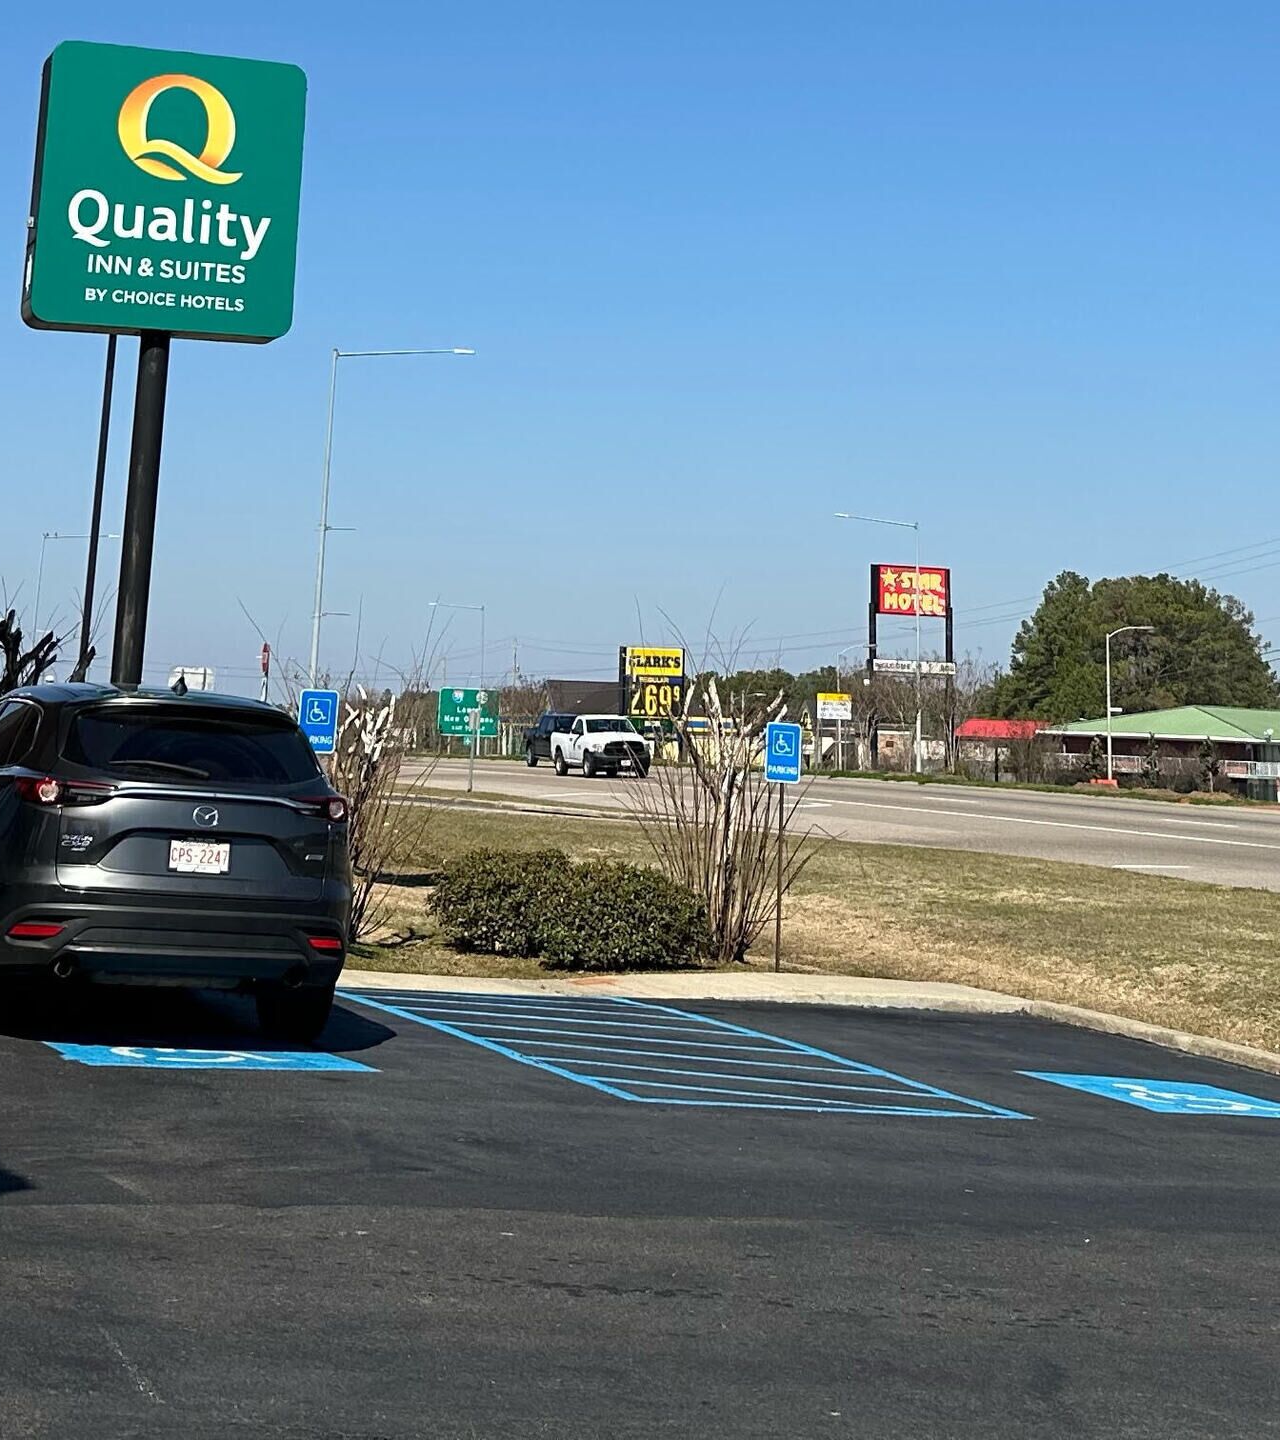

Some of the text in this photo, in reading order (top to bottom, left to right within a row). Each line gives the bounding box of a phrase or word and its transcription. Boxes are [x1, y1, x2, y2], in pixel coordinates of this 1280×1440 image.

[67, 188, 272, 261] Quality
[87, 253, 247, 284] INN & SUITES
[84, 287, 245, 312] BY CHOICE HOTELS
[899, 571, 944, 592] STAR
[883, 592, 944, 614] MOTEL
[309, 735, 333, 745] RKING
[768, 764, 798, 775] PARKING
